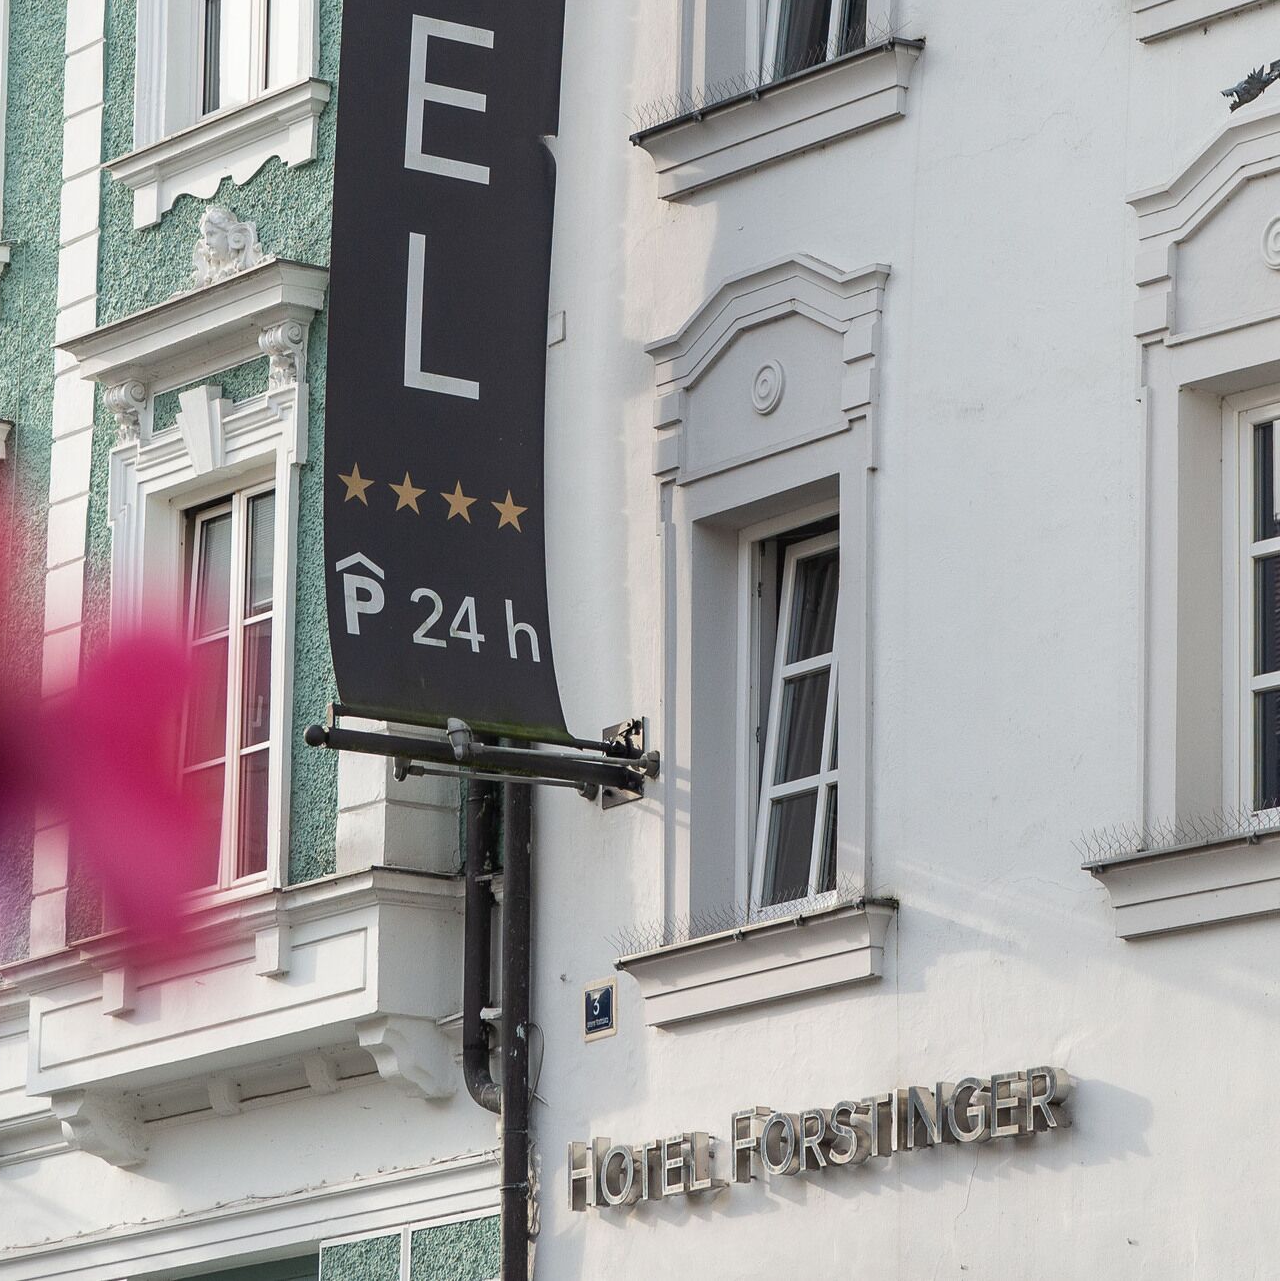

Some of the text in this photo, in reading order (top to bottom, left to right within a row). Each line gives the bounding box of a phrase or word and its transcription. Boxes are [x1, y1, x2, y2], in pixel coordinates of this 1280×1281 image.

[342, 571, 542, 663] P 24 h
[592, 994, 600, 1016] 3
[567, 1065, 1066, 1212] HOTEL FORSTINGER
